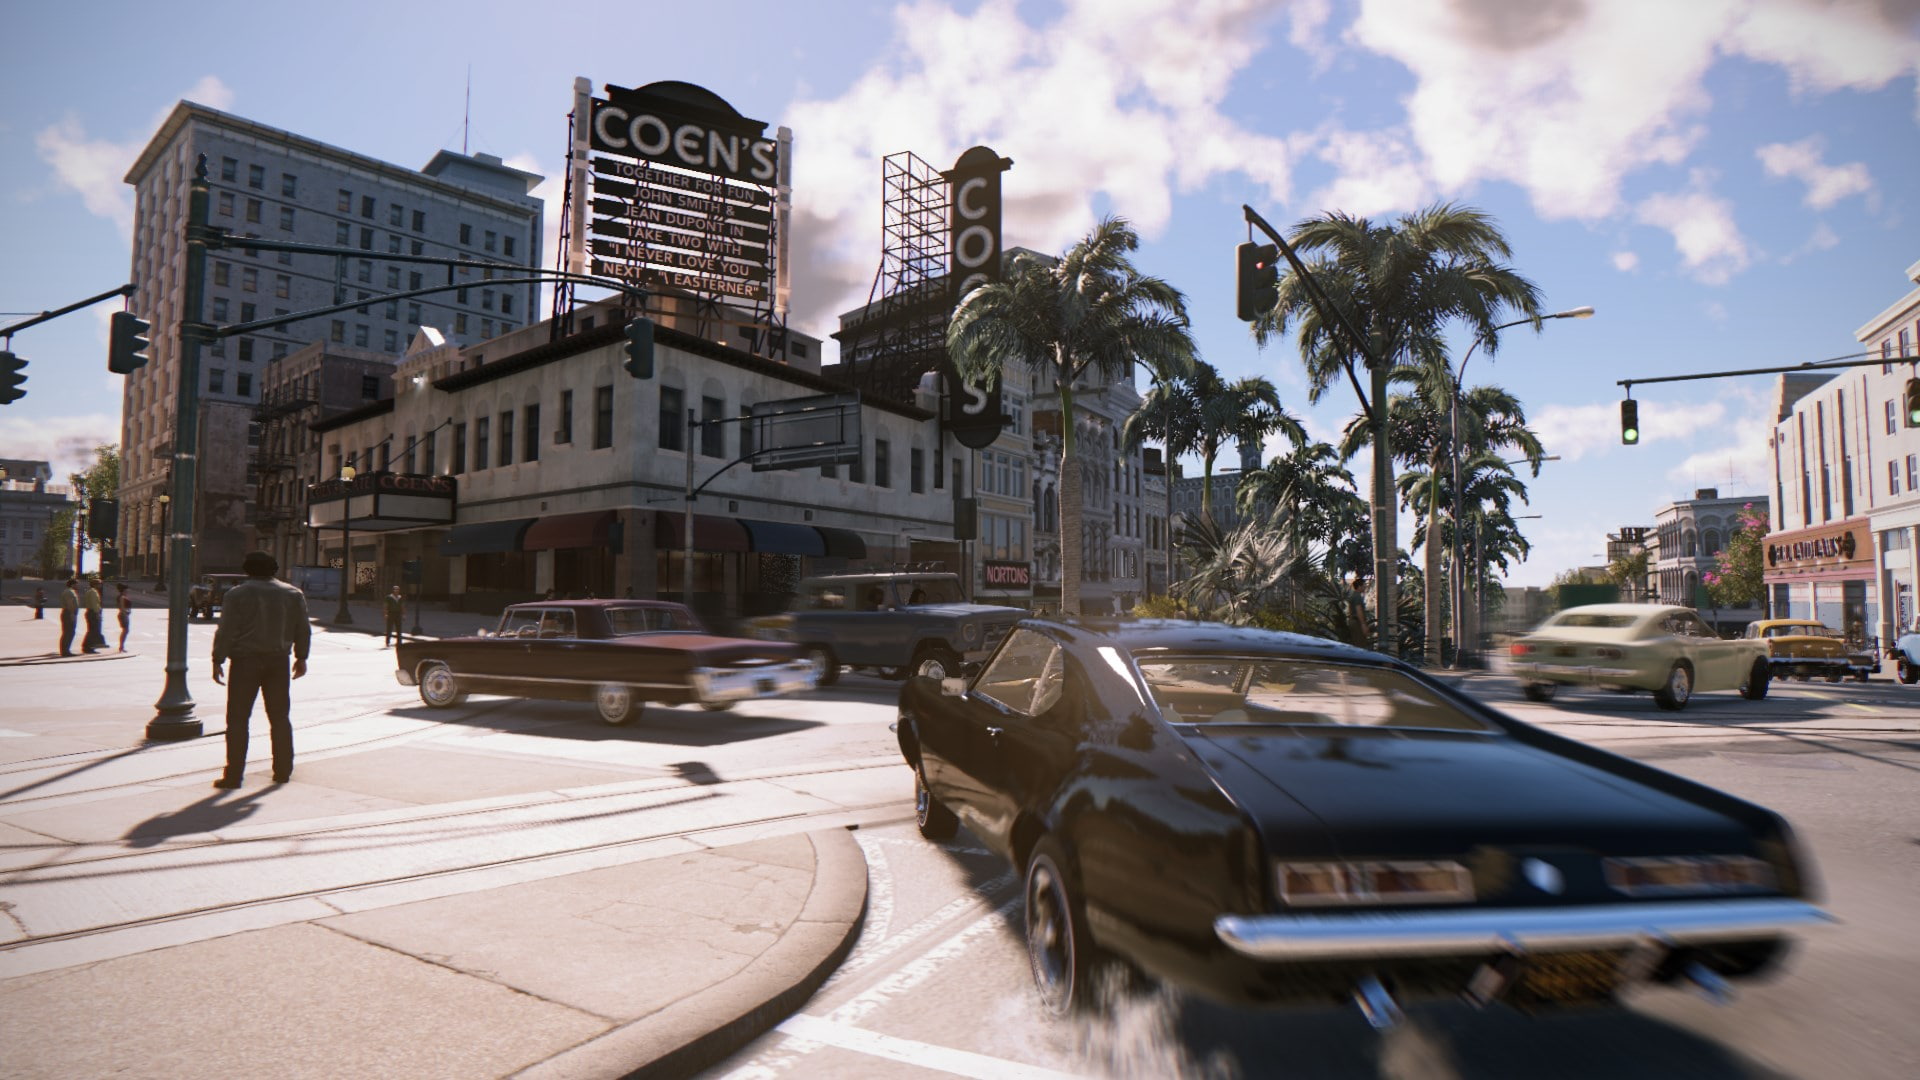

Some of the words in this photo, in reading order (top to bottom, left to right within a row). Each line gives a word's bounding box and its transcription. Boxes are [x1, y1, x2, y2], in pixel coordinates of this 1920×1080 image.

[595, 107, 774, 180] COEN'S
[614, 162, 689, 188] TOGETHER
[695, 179, 722, 195] FOR
[728, 186, 755, 201] FUN
[632, 186, 672, 204] JOHN
[678, 195, 720, 213] SMITH
[725, 205, 735, 217] &
[624, 205, 660, 222] JEAN
[665, 212, 725, 234] DUPONT
[730, 224, 744, 237] IN
[625, 225, 663, 242] TAKE
[668, 232, 701, 249] TWO
[706, 240, 742, 256] WITH
[602, 262, 643, 279] NEXT
[625, 246, 673, 263] NEVER
[679, 253, 716, 271] LOVE
[720, 261, 749, 276] YOU
[986, 565, 1029, 584] NORTONS
